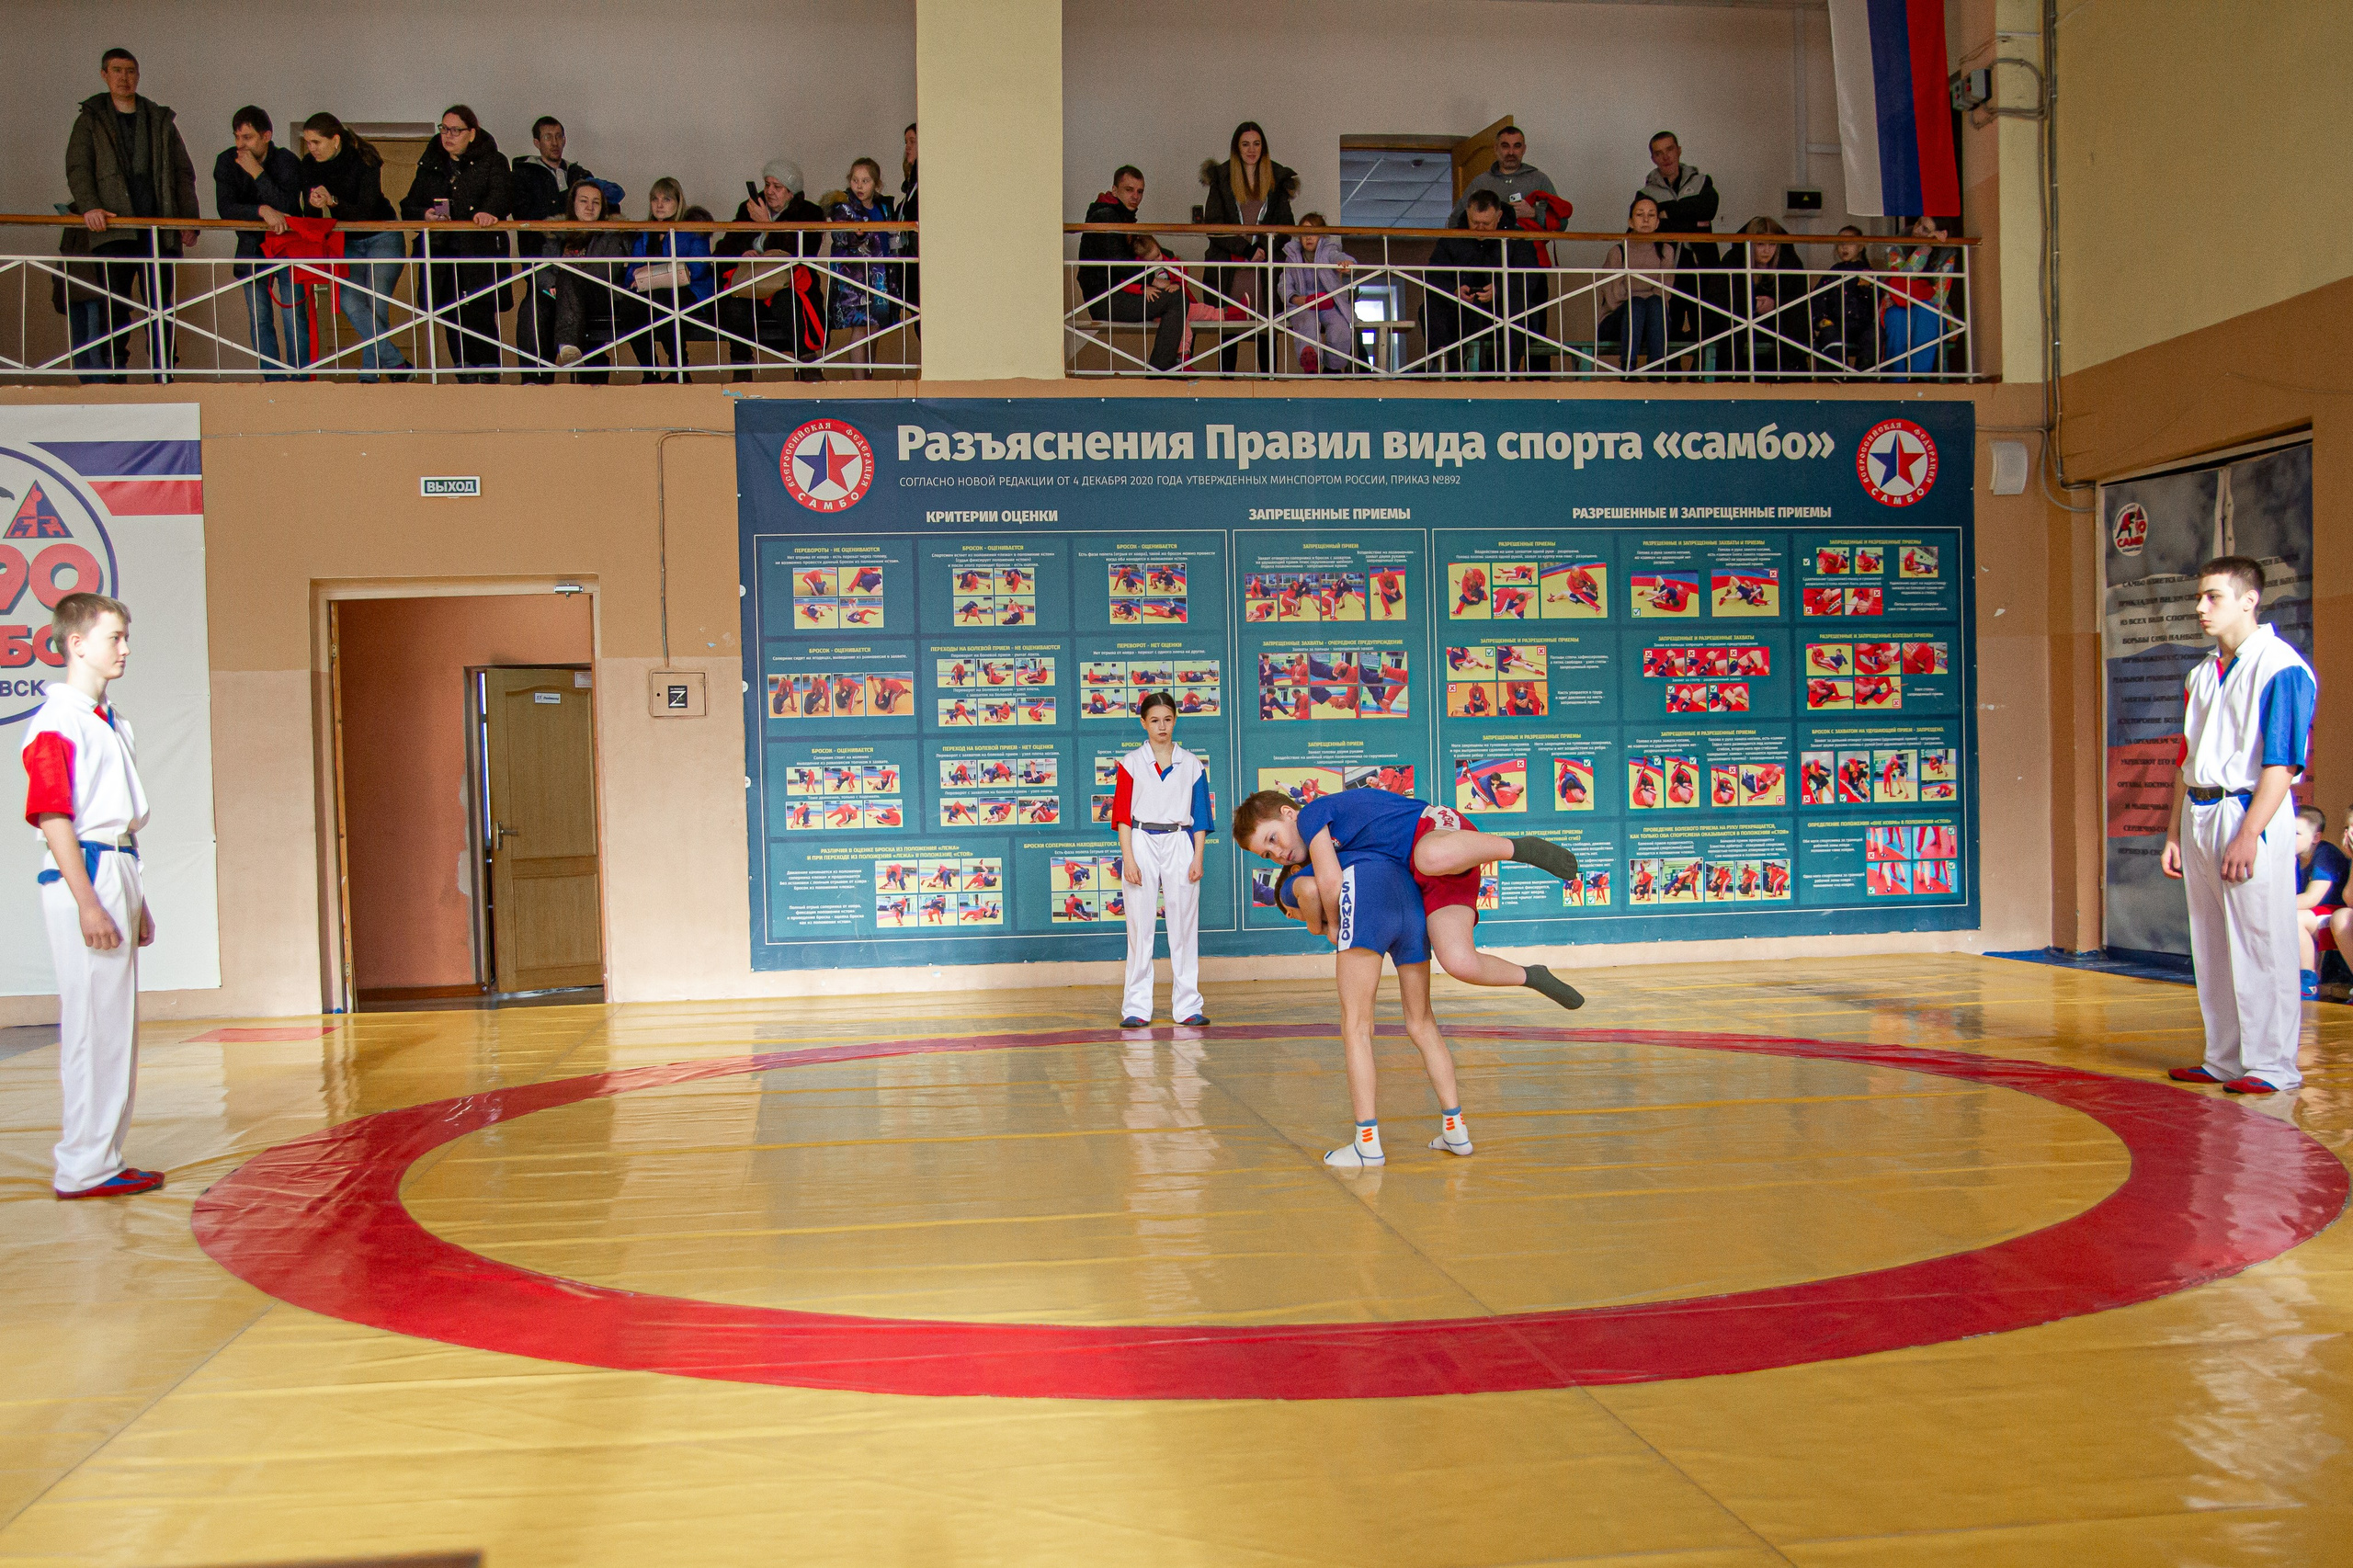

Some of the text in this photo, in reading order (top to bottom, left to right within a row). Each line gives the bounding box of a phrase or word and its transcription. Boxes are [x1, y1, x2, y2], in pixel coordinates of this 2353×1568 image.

[783, 423, 871, 487] ВСЕРОССИЙСКАЯ ФЕДЕРАЦИЯ
[898, 423, 1836, 470] Разъяснения Правил вида спорта «самбо»
[1859, 423, 1936, 483] ВСЕРОССИЙСКАЯ ФЕДЕРАЦИЯ
[426, 481, 474, 493] ВЫХОД
[899, 475, 1461, 487] СОГЛАСНО НОВОЙ РЕДАКЦИИ ОТ 4 ДЕКАБРЯ 2020 ГОДА УТВЕРЖДЕННЫХ МИНСПОРТОМ РОССИИ, ПРИКАЗ №892
[798, 492, 859, 510] САМБО
[1870, 488, 1924, 505] САМБО
[926, 510, 1058, 524] КРИТЕРИИ ОЦЕНКИ
[1249, 508, 1411, 523] ЗАПРЕЩЕННЫЕ ПРИЕМЫ
[1573, 507, 1831, 520] РАЗРЕШЕННЫЕ И ЗАПРЕЩЕННЫЕ ПРИЕМЫ
[1341, 881, 1352, 941] SAMBO
